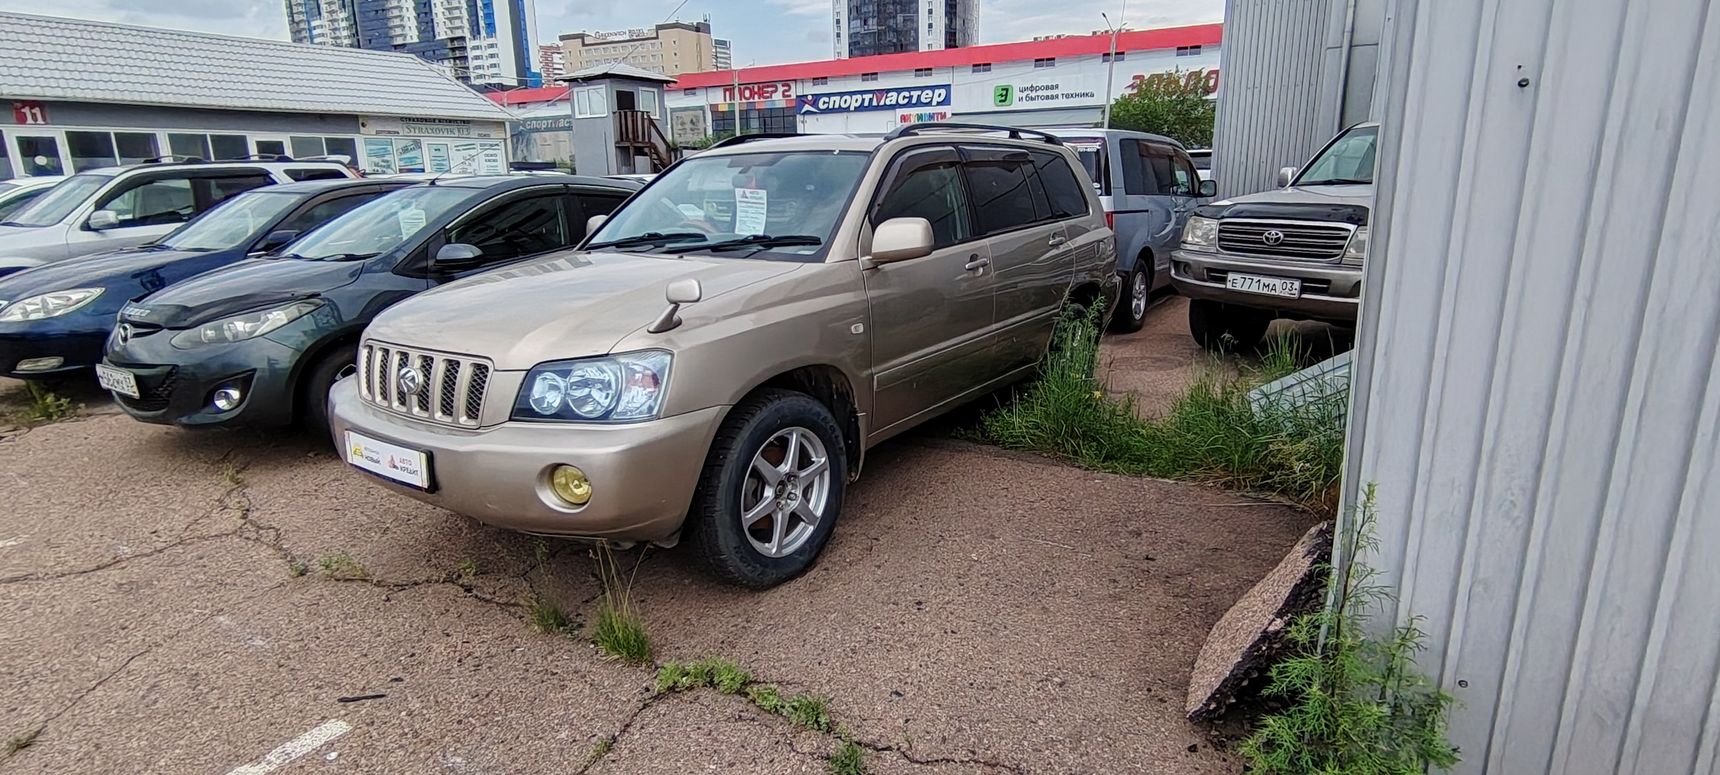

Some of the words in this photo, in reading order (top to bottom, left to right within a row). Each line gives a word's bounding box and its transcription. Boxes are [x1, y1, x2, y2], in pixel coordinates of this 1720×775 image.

[1018, 83, 1060, 93] цифровая
[1024, 93, 1059, 102] бытовая
[1061, 91, 1095, 100] техника
[21, 106, 46, 125] 11
[1281, 281, 1295, 292] 03
